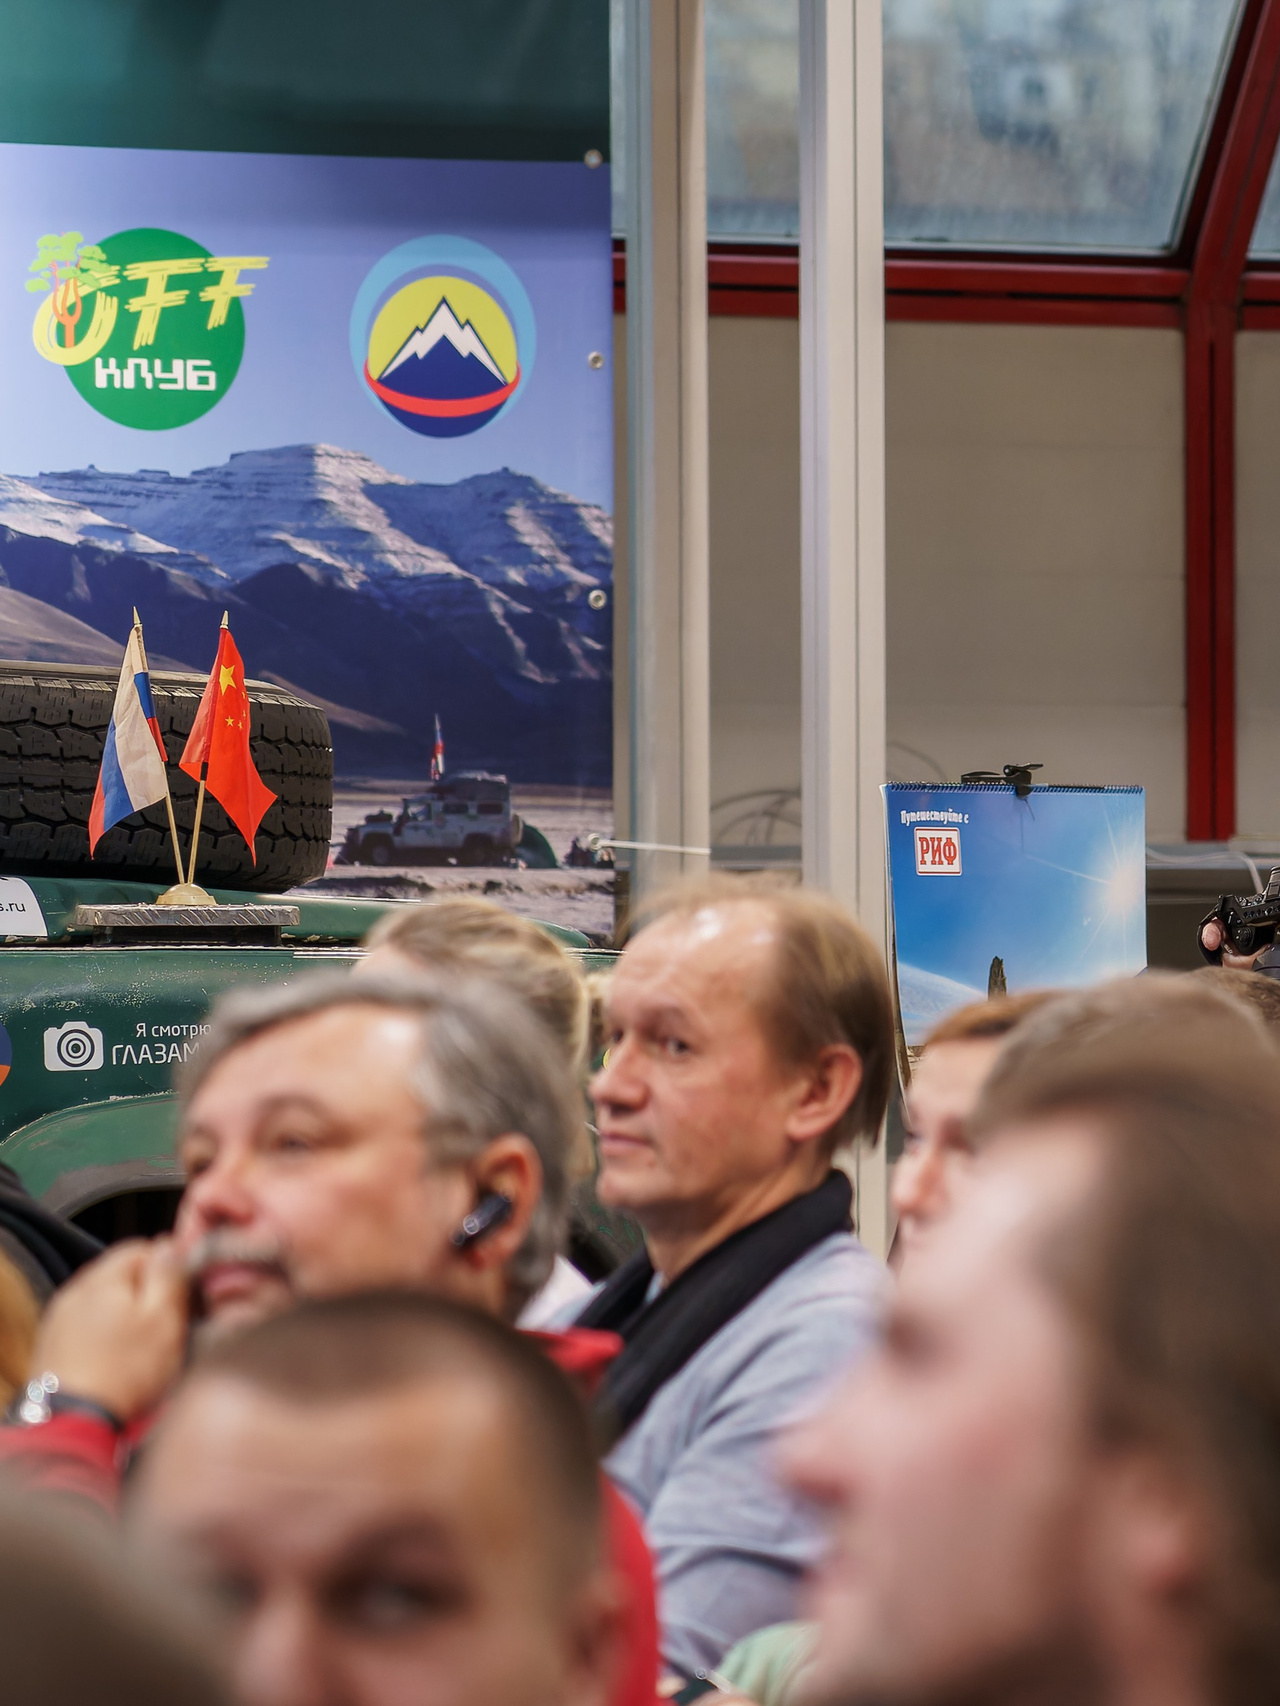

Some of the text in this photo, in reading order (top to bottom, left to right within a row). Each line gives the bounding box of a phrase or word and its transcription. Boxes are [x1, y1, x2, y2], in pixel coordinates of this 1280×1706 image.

[33, 256, 270, 366] OFF
[95, 357, 217, 391] КЛУБ
[900, 808, 969, 827] Путешествуйте с
[918, 836, 957, 865] РИФ
[135, 1022, 212, 1039] Я смотрю
